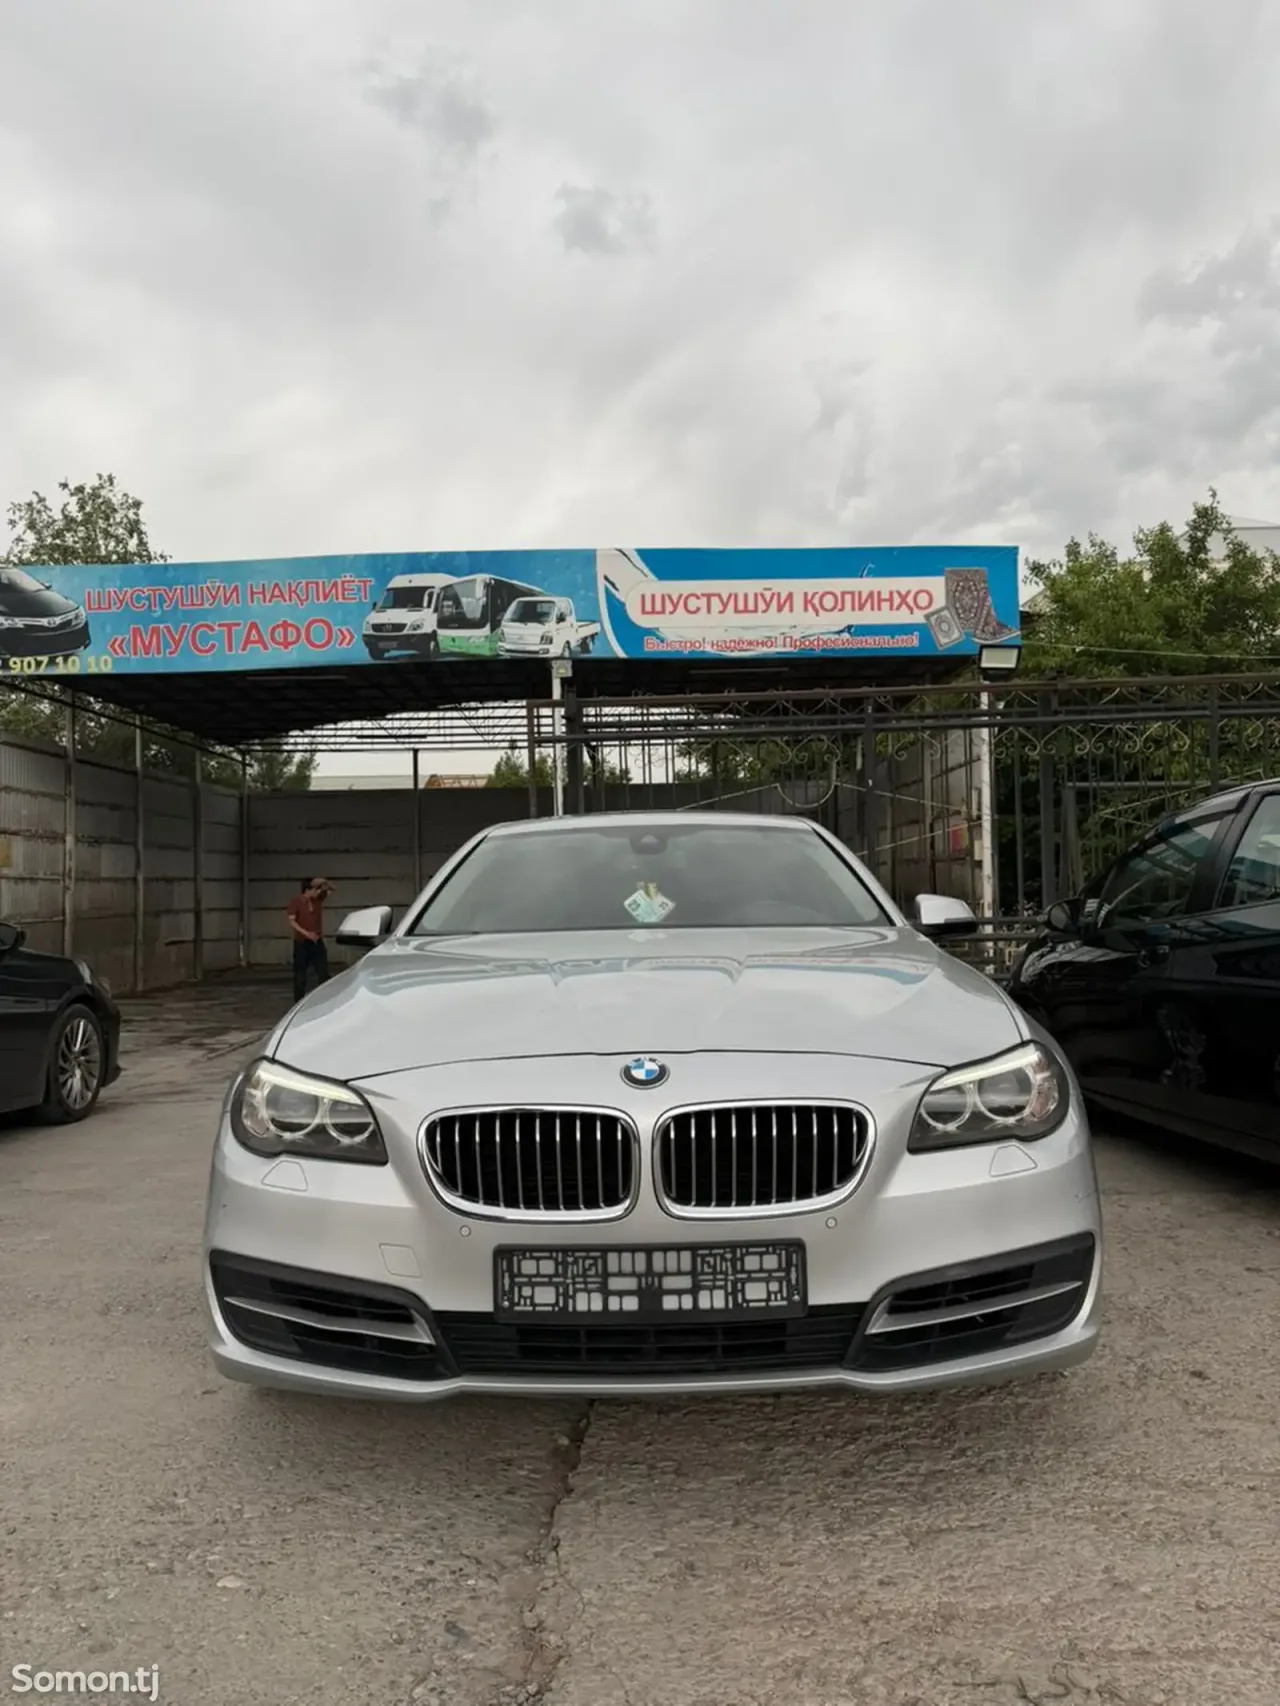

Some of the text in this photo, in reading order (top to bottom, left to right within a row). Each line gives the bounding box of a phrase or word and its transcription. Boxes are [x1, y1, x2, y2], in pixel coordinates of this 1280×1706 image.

[85, 573, 374, 612] ШУСТУШӮИ НАҚЛИЁТ
[640, 587, 934, 617] ШУСТУШӮИ ҚОЛИНҲО
[107, 617, 357, 657] «МУСТАФО»
[8, 655, 113, 674] 907 10 10
